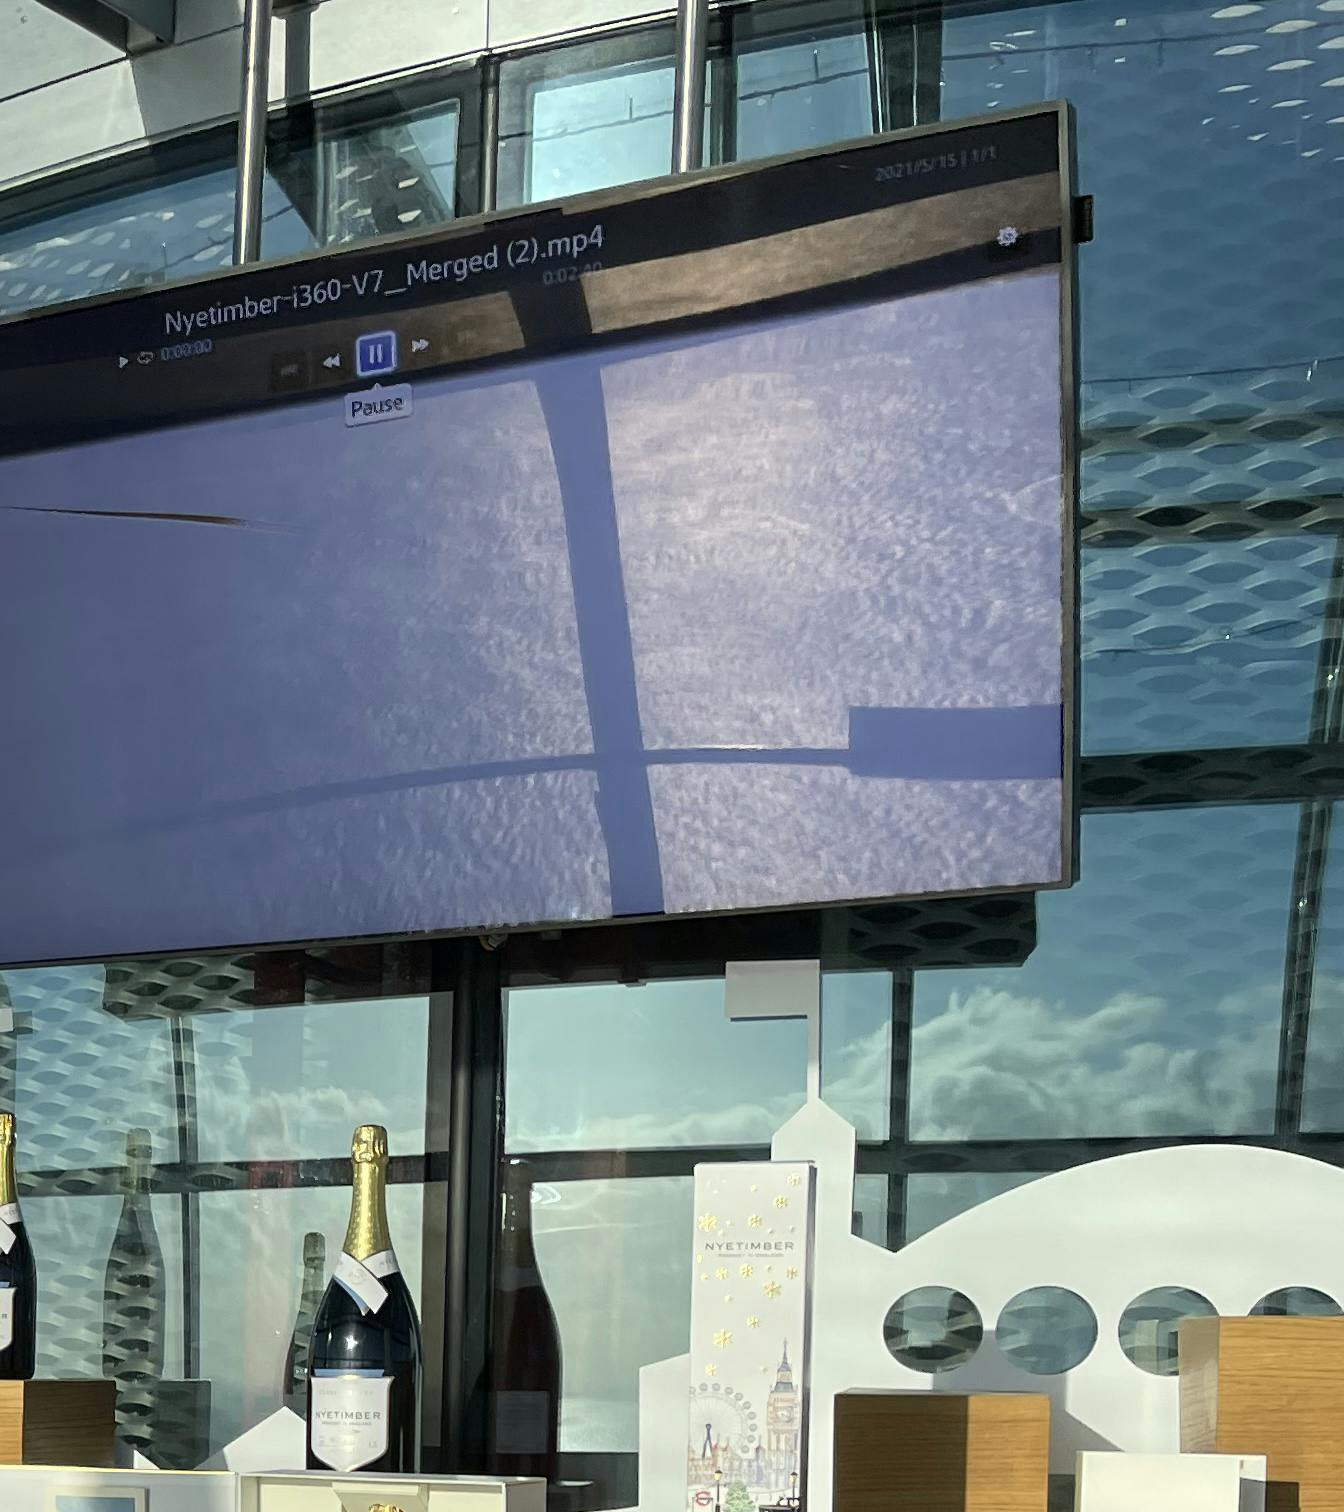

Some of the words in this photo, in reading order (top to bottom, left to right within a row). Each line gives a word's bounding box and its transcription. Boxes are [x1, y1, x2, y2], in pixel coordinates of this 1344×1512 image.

[507, 224, 604, 269] (2).mp4
[351, 394, 404, 419] Pause
[704, 1241, 795, 1251] NYETIMBER
